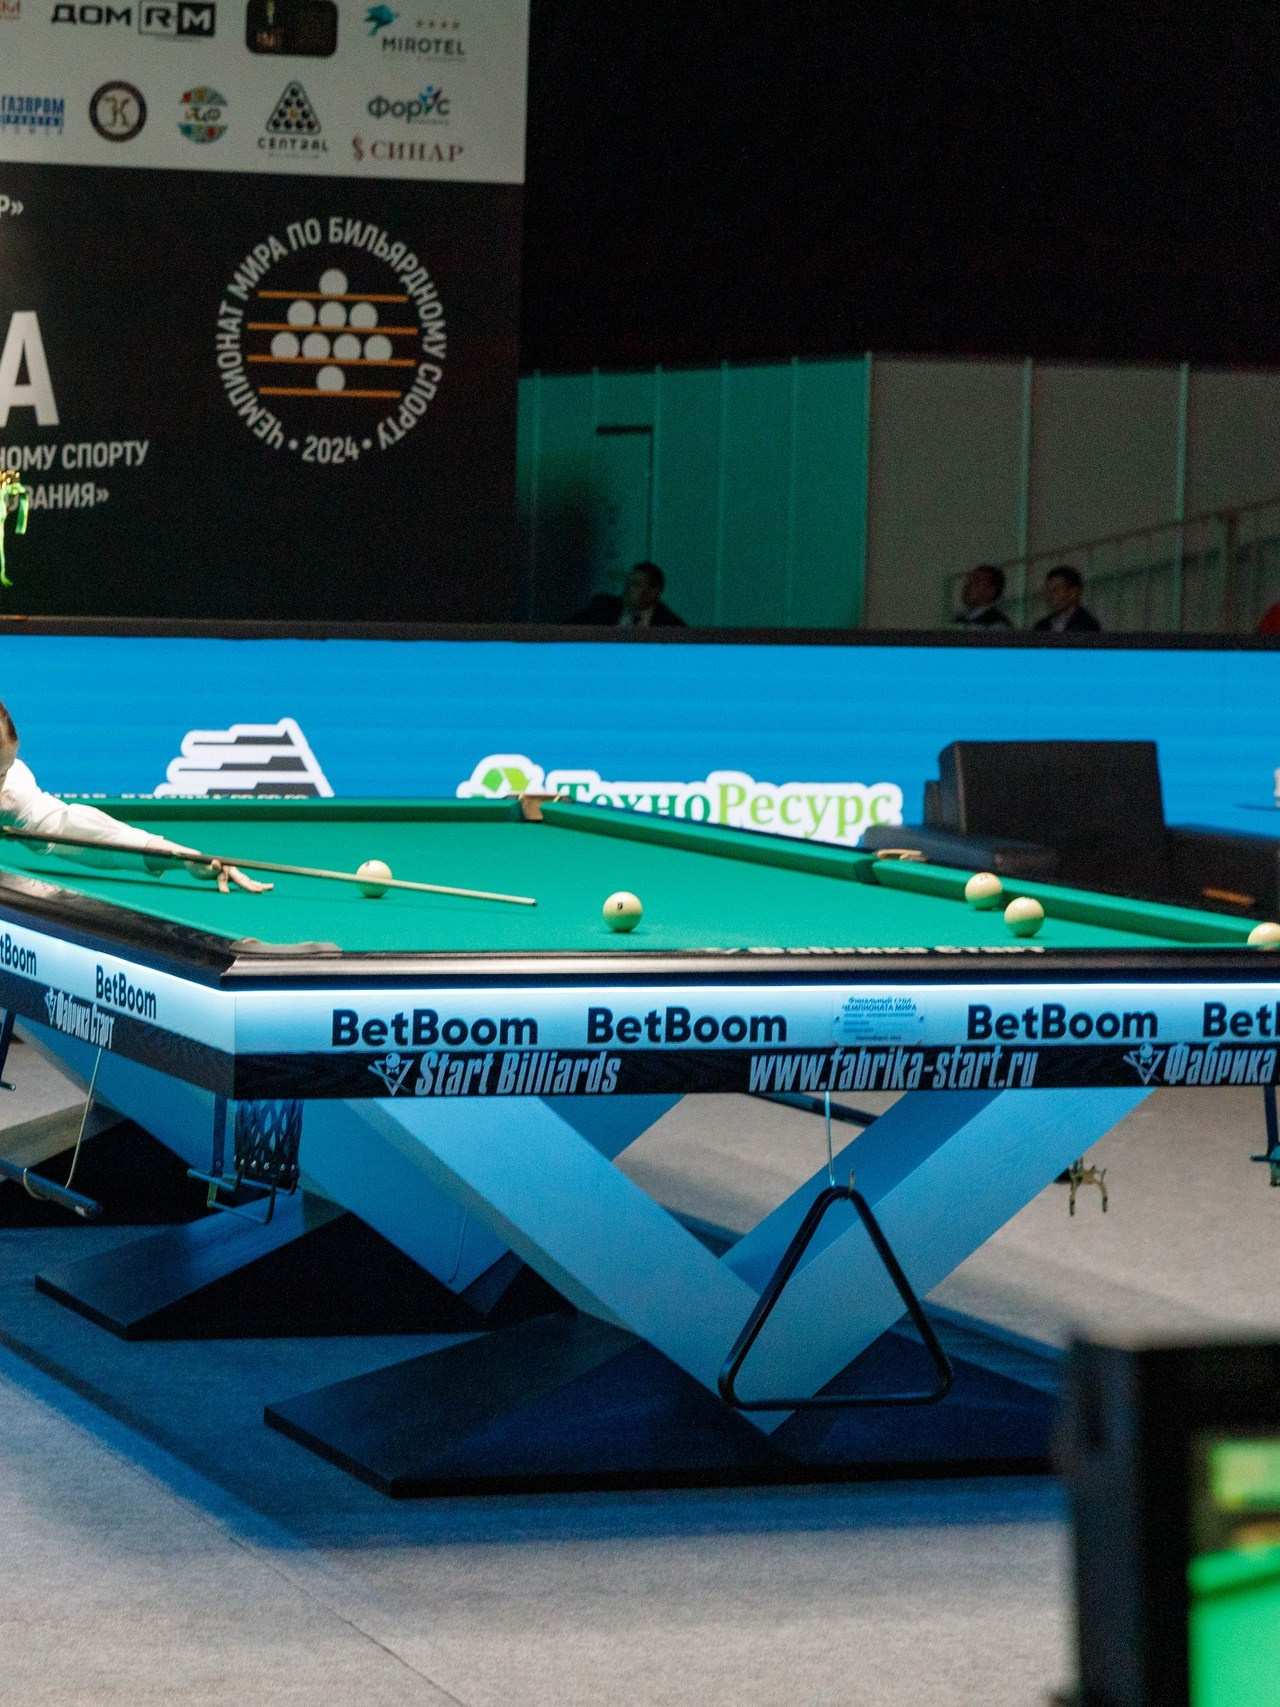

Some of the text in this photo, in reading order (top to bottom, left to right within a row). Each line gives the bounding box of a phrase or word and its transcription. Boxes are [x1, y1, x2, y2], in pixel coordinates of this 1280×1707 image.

[52, 3, 133, 26] ДОМ
[381, 36, 466, 56] MIROTEL
[285, 217, 321, 252] ПО
[226, 234, 289, 301] МИРА
[328, 216, 448, 360] БИЛЬЯРДНОМУ
[216, 300, 285, 450] ЧЕМПИОНАТ
[375, 362, 444, 450] СПОРТУ
[61, 439, 150, 470] СПОРТУ
[301, 433, 360, 464] 2024
[96, 964, 157, 1019] BetBoom
[55, 990, 115, 1050] Фабрика Старт
[331, 1008, 538, 1047] BetBoom
[587, 1006, 788, 1044] BetBoom
[967, 1004, 1158, 1040] BetBoom
[415, 1050, 621, 1096] Start Billiards
[748, 1046, 1038, 1092] www.fabrika-start.ru
[1163, 1042, 1277, 1086] Фабрика
